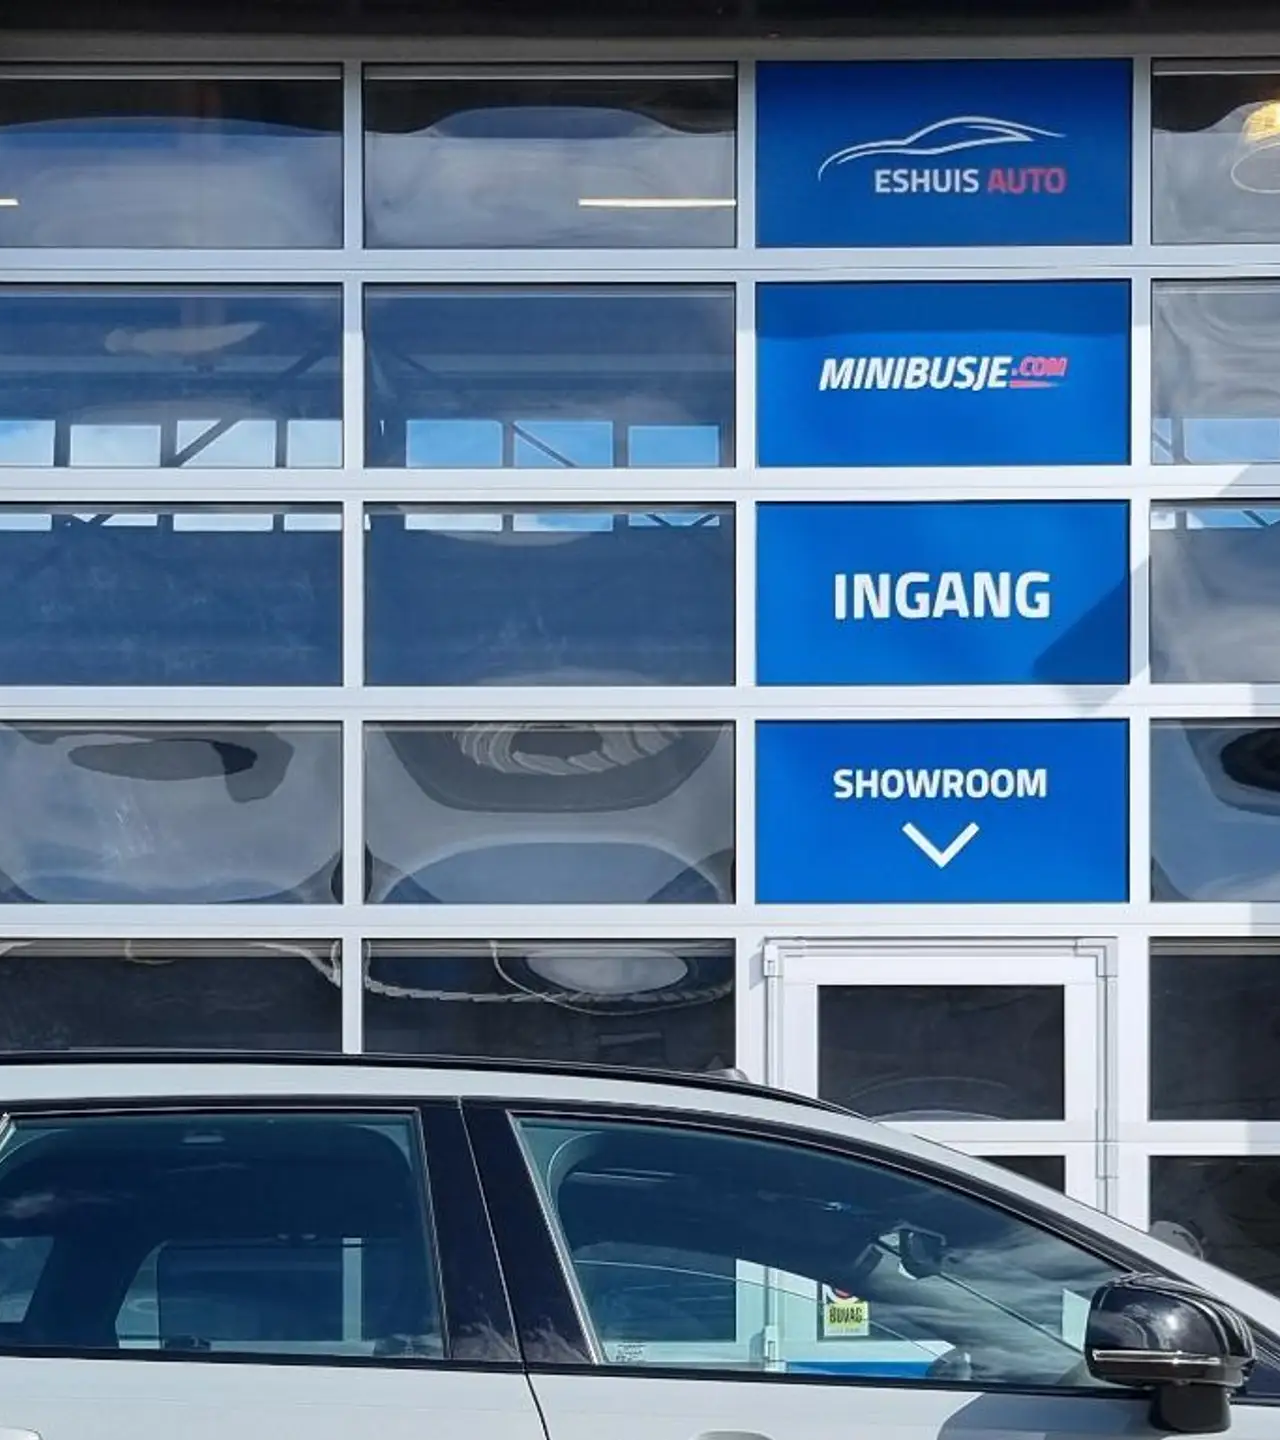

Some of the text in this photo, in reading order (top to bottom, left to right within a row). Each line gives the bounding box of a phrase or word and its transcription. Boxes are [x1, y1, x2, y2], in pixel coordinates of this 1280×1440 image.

[874, 167, 1068, 194] ESHUIS AUTO
[819, 355, 1068, 391] MINIBUSJE.COM
[834, 571, 1051, 620] INGANG
[833, 768, 1047, 799] SHOWROOM
